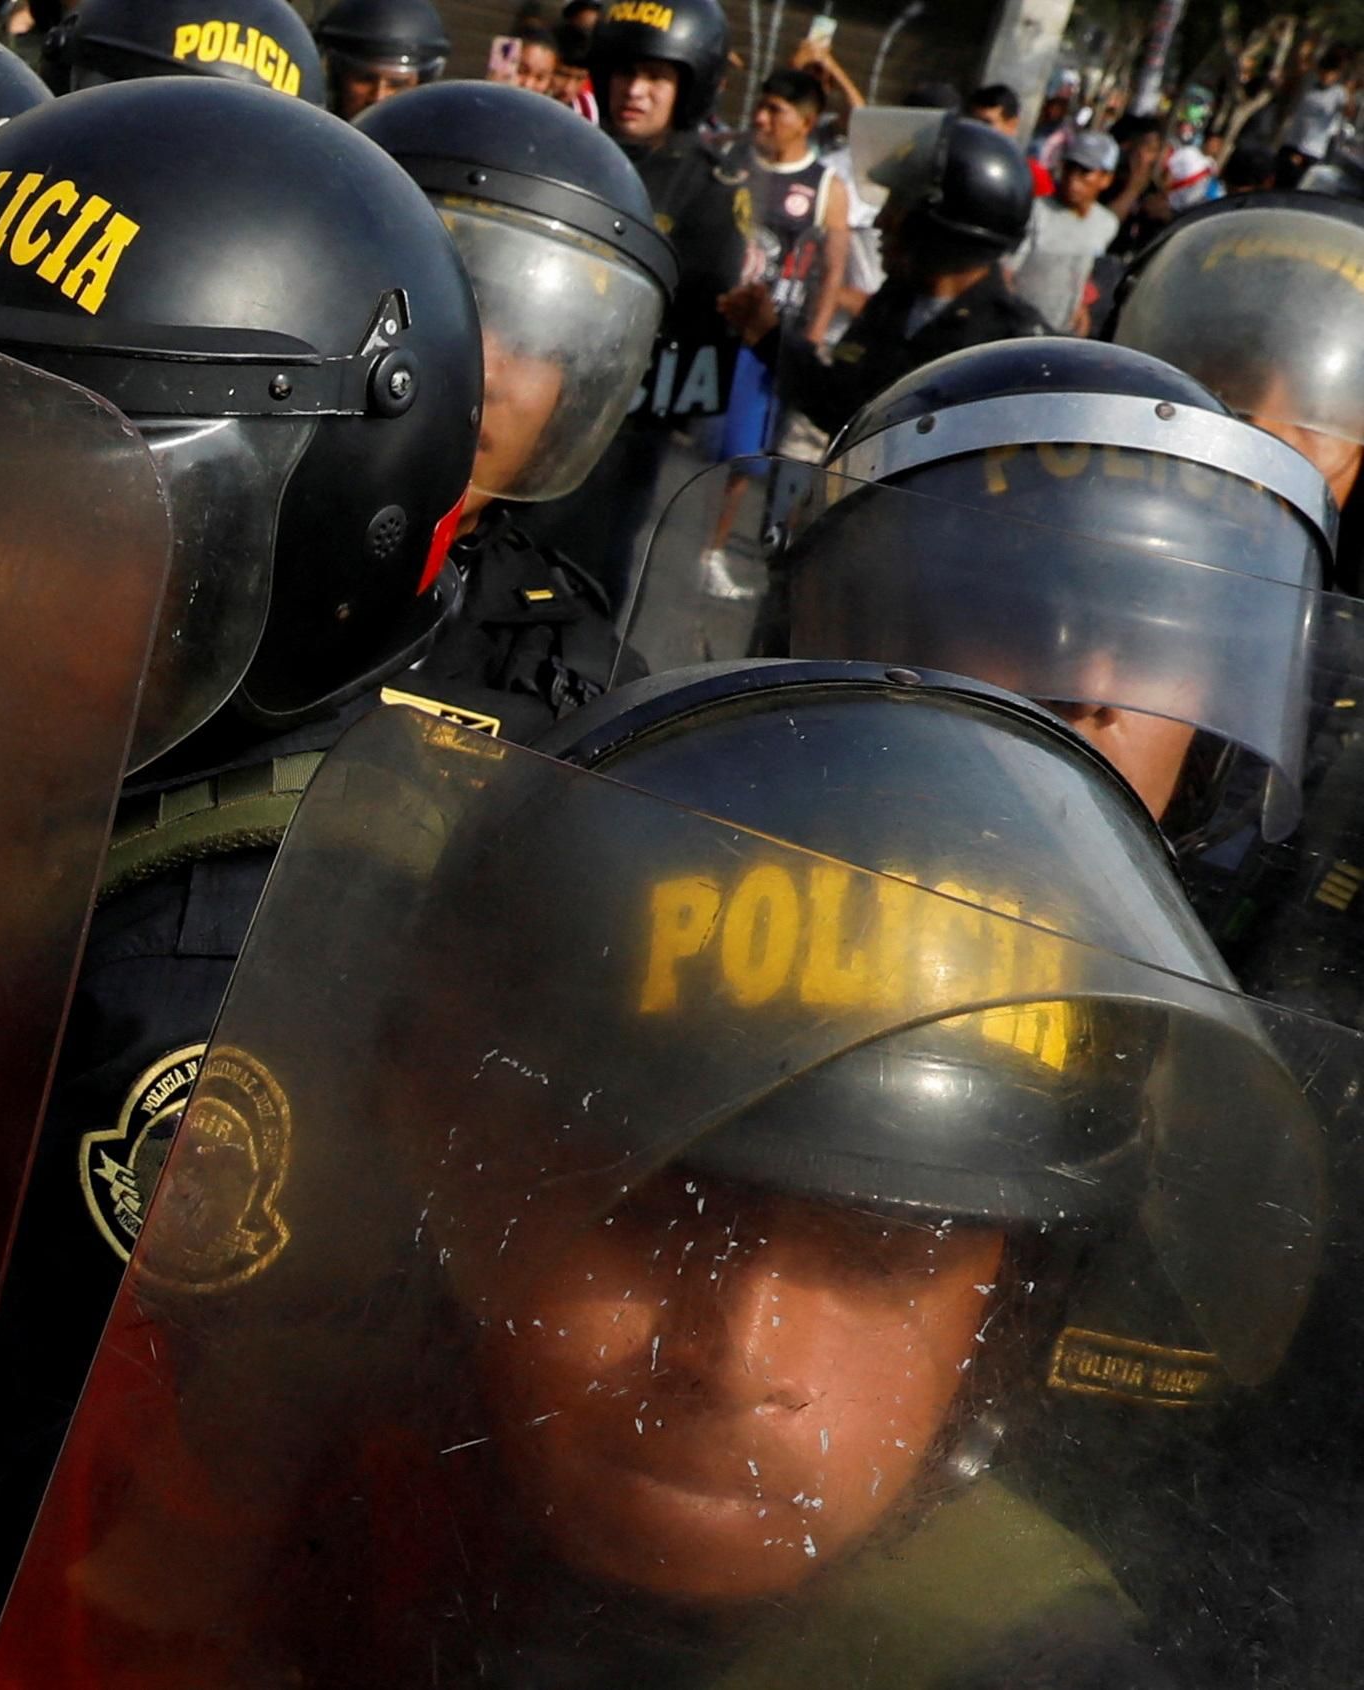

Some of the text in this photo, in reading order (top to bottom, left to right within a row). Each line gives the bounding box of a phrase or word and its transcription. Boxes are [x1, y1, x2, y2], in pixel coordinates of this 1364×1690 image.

[606, 2, 673, 32] POLICIA
[173, 20, 301, 97] POLICIA
[638, 864, 1069, 1073] POLICIA
[141, 1068, 187, 1116] POLICIA
[1065, 1351, 1145, 1386] POLICIA
